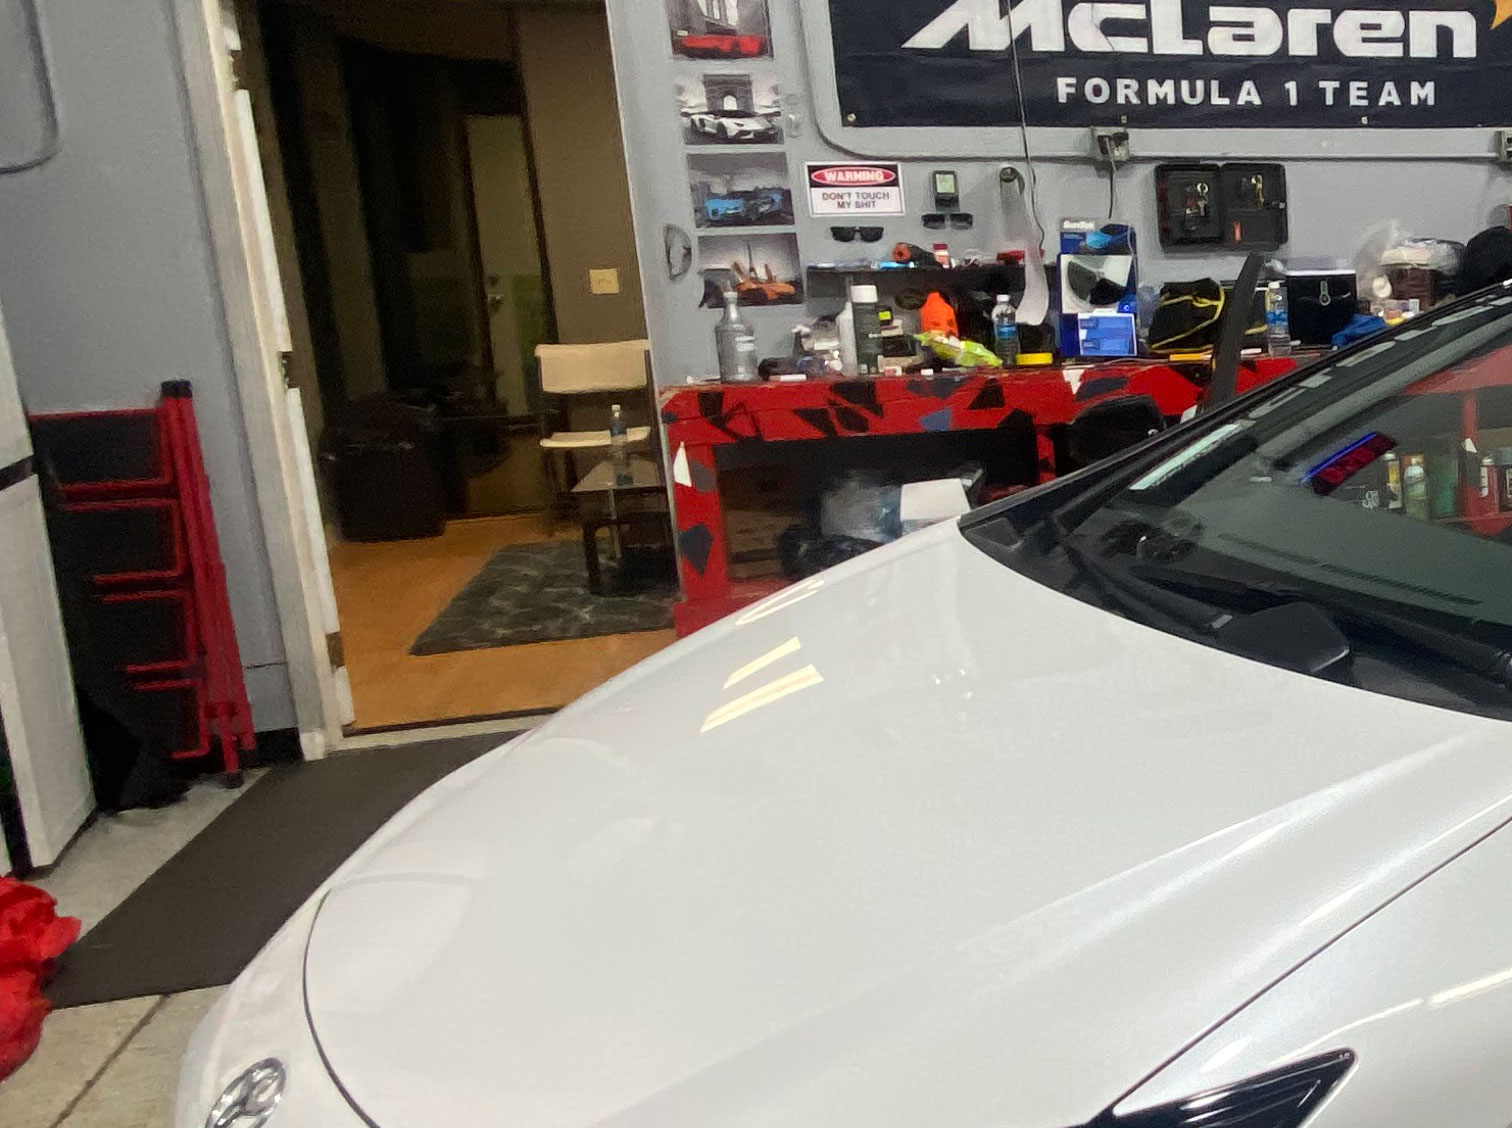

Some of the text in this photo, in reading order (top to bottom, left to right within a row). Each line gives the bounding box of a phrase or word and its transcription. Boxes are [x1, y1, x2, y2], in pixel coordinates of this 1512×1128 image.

[900, 0, 1477, 58] McLaren
[1055, 76, 1436, 107] FORMULA 1 TEAM
[823, 170, 884, 182] WARNING
[822, 191, 890, 201] DON'T TOUCH
[836, 200, 877, 209] MY SHIT
